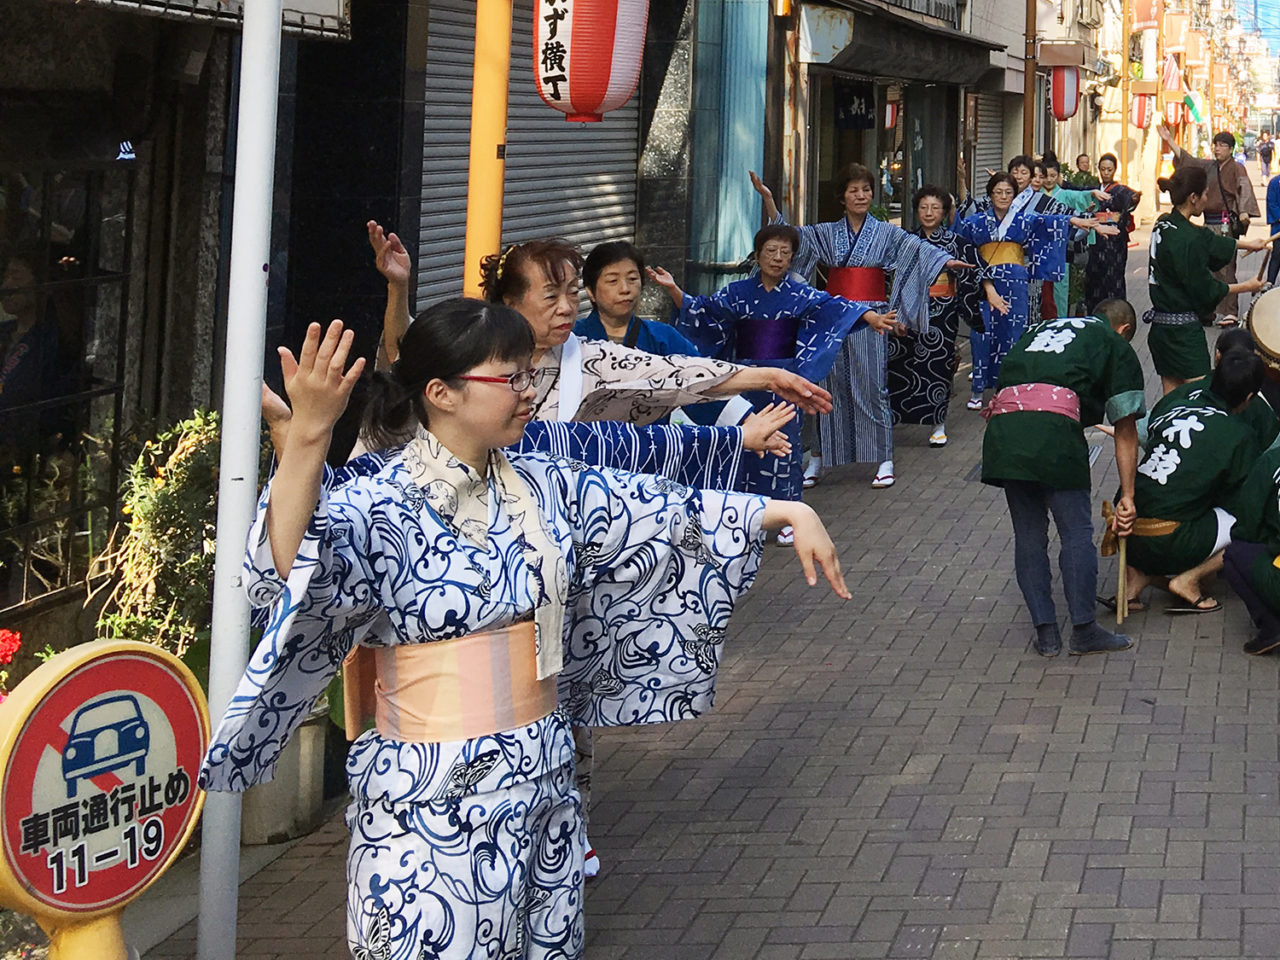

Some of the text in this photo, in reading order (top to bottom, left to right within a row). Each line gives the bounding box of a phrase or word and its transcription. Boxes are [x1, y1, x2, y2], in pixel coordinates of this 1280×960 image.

[20, 767, 190, 856] 車両通行止め
